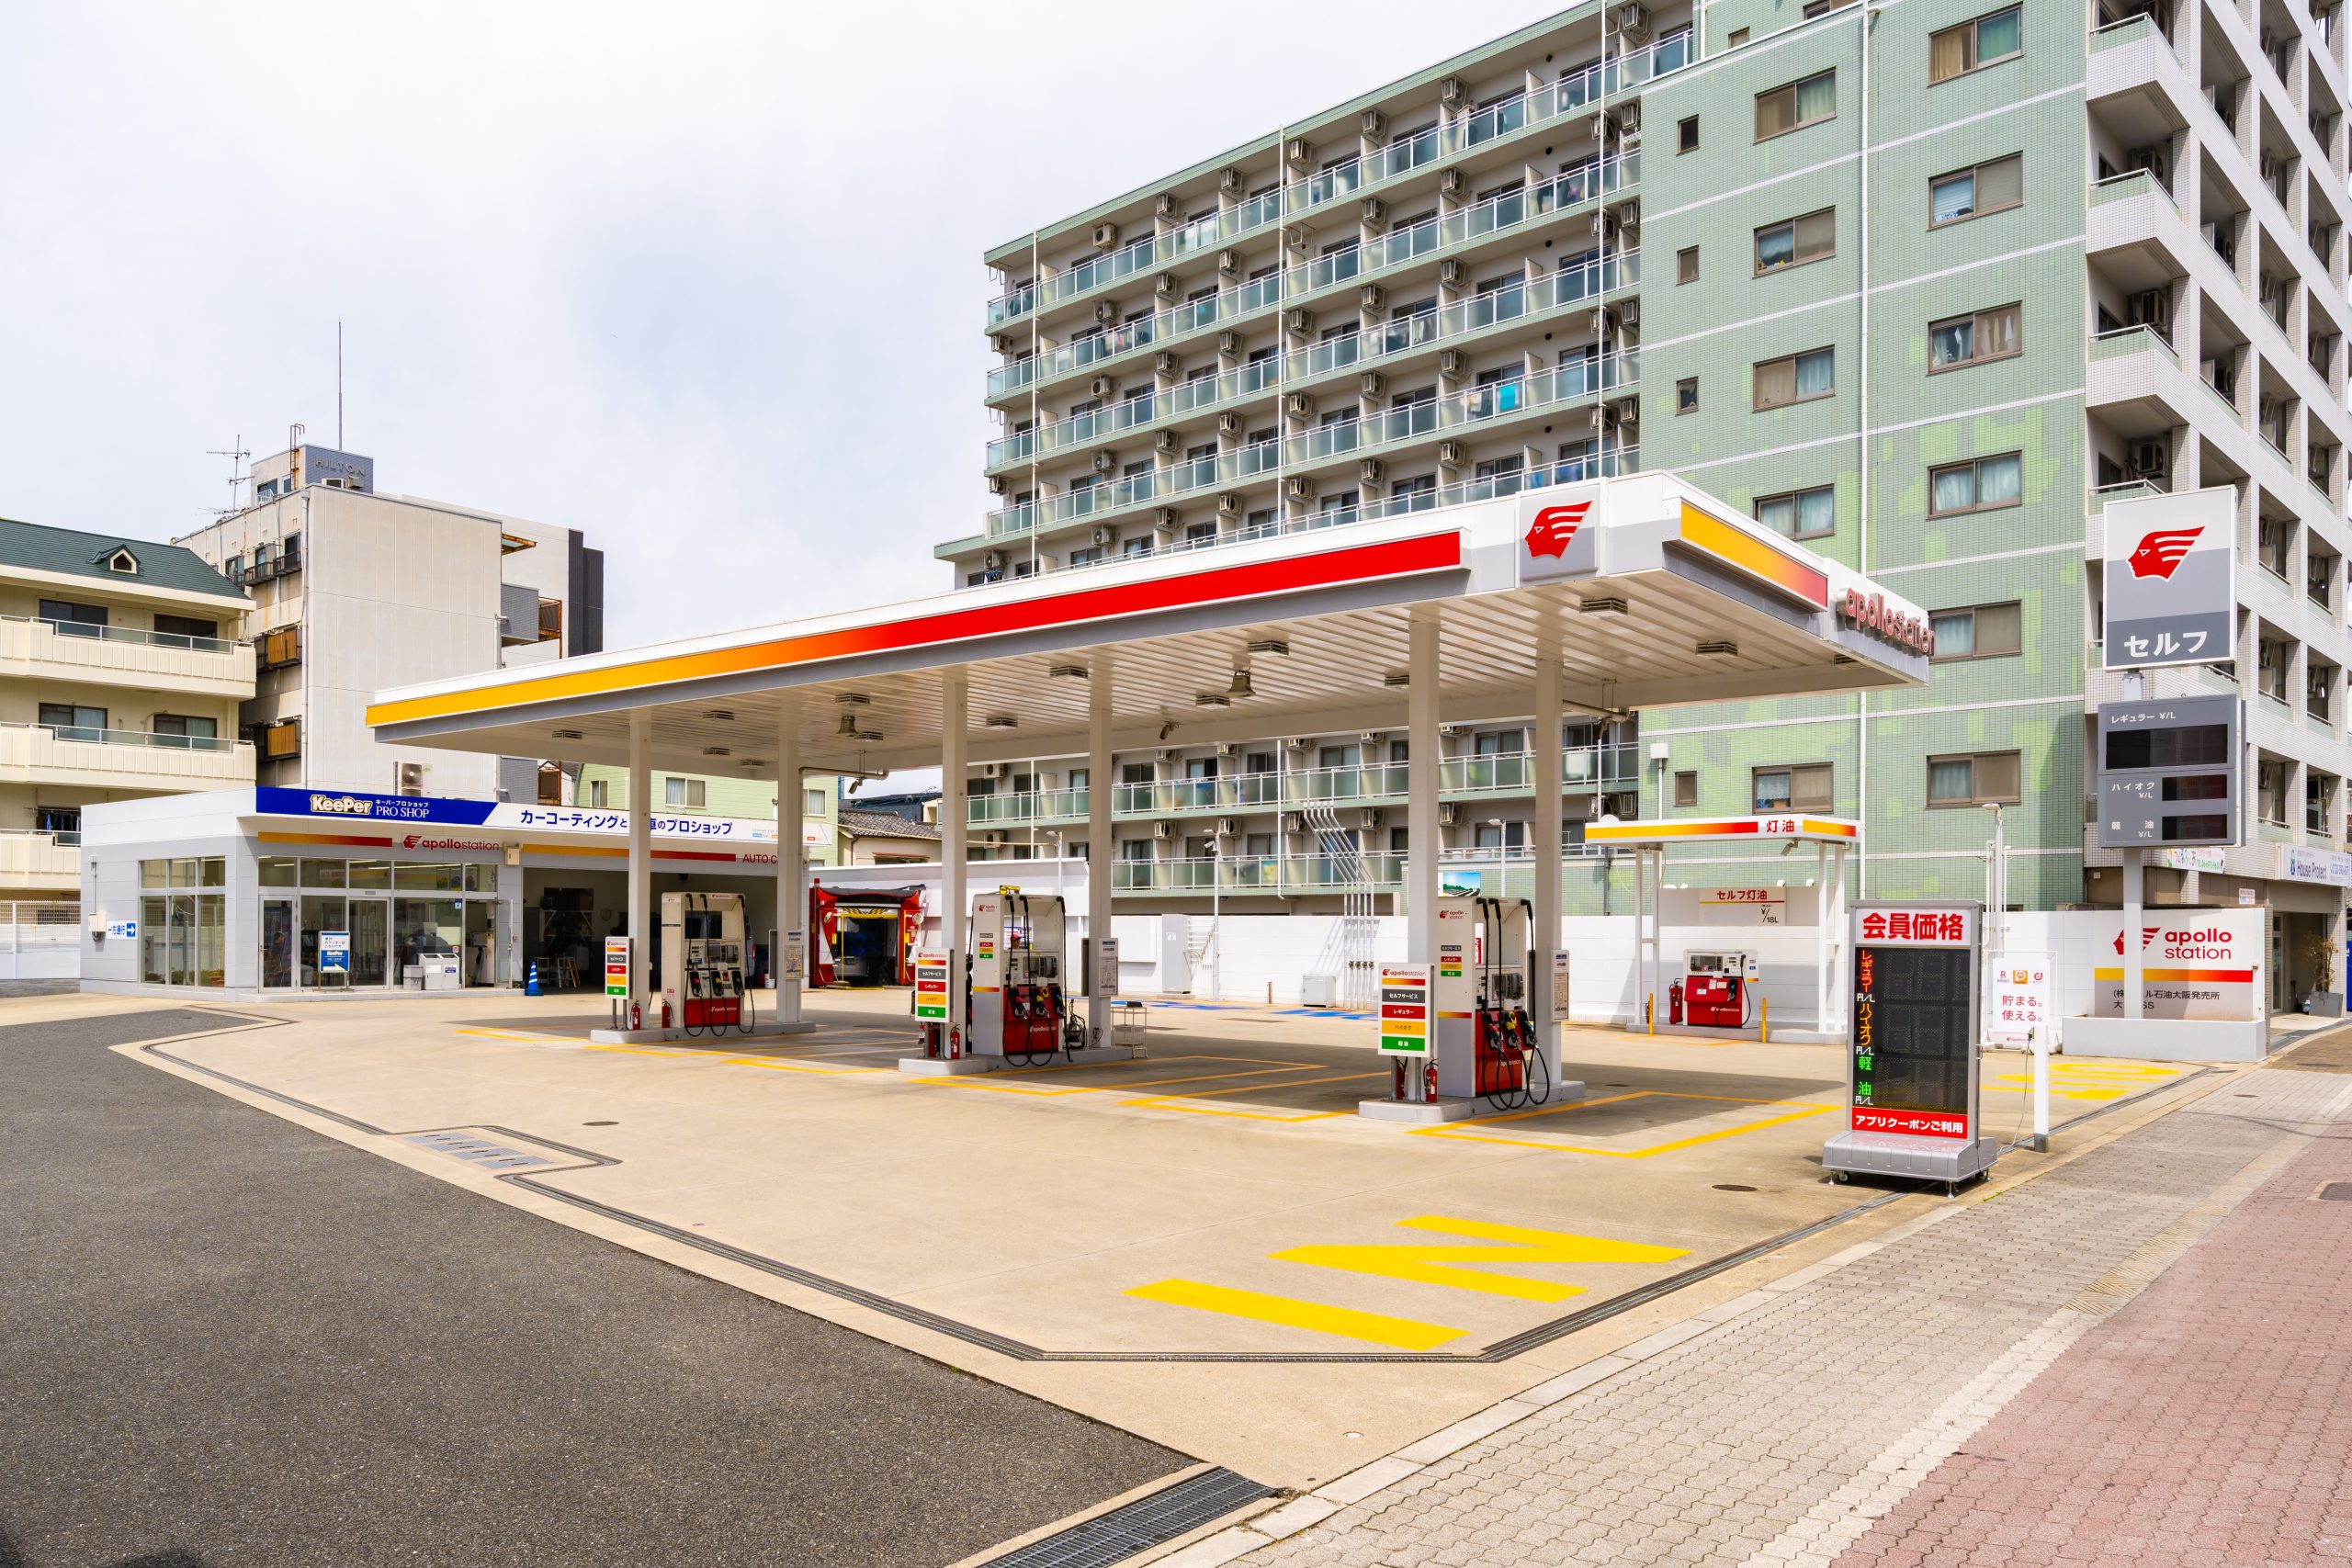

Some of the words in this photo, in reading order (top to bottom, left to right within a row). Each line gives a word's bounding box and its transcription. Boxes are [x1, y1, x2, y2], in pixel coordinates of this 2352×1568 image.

[2123, 630, 2208, 658] セルフ
[2111, 714, 2155, 724] レギュラー
[2159, 711, 2177, 720] ¥/L
[2111, 782, 2155, 792] ハイオク
[311, 795, 373, 816] KeePer
[375, 799, 429, 808] キーパープロショップ
[376, 806, 399, 817] PRO
[400, 807, 430, 818] SHOP
[521, 810, 732, 834] カーコーティングと車のプロショップ
[1766, 819, 1795, 833] 灯油
[422, 839, 500, 851] apollostation
[742, 853, 769, 863] AUTO
[1716, 889, 1768, 900] セルフ灯油
[1862, 912, 1964, 942] 会員価格
[2165, 928, 2233, 946] apollo
[2165, 945, 2232, 960] station
[1861, 949, 1873, 993] レギュラー
[2002, 995, 2042, 1008] 貯まる。
[2001, 1010, 2042, 1022] 使える。
[1859, 1002, 1872, 1046] ハイオク
[1855, 1113, 1964, 1134] アプリクーポンご利用
[1120, 1214, 1693, 1351] IN
